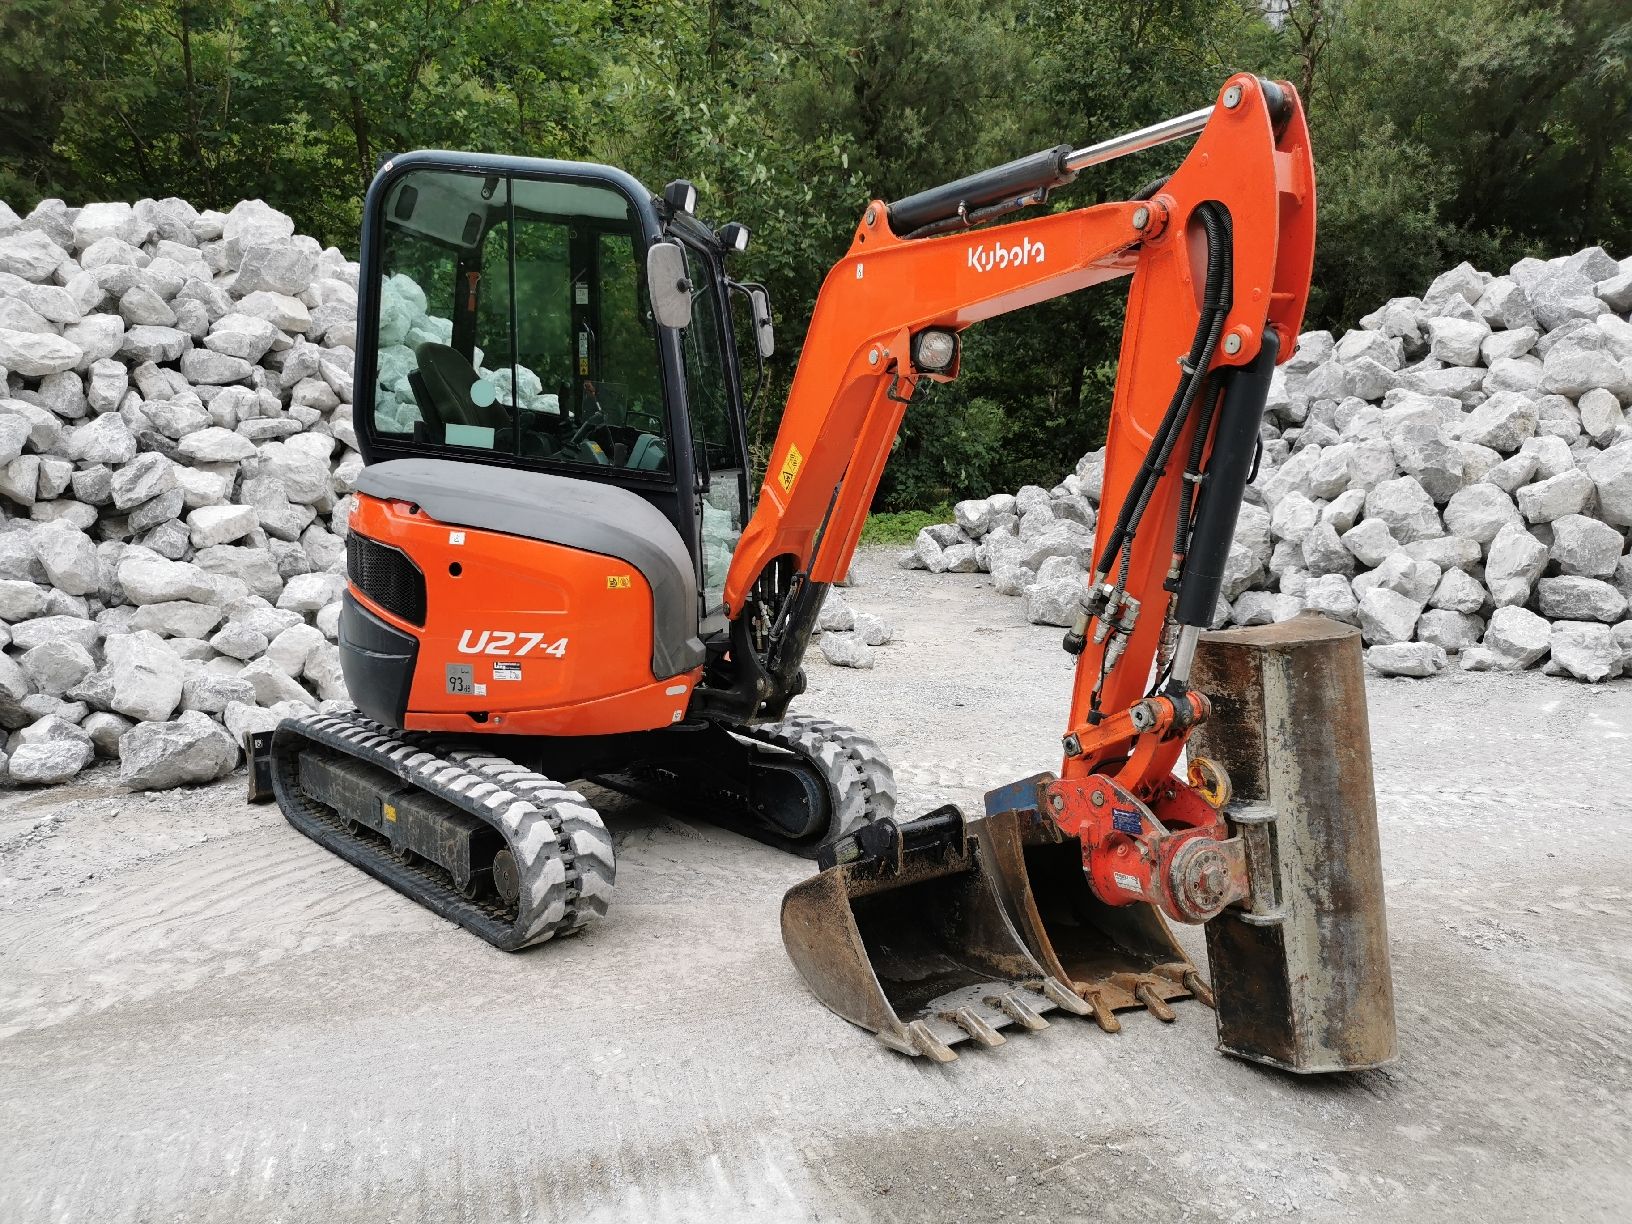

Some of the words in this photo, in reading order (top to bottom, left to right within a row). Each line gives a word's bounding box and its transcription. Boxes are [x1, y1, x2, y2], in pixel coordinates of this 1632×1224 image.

[967, 236, 1045, 273] Kubota
[457, 629, 568, 658] U27-4
[449, 676, 464, 692] 93
